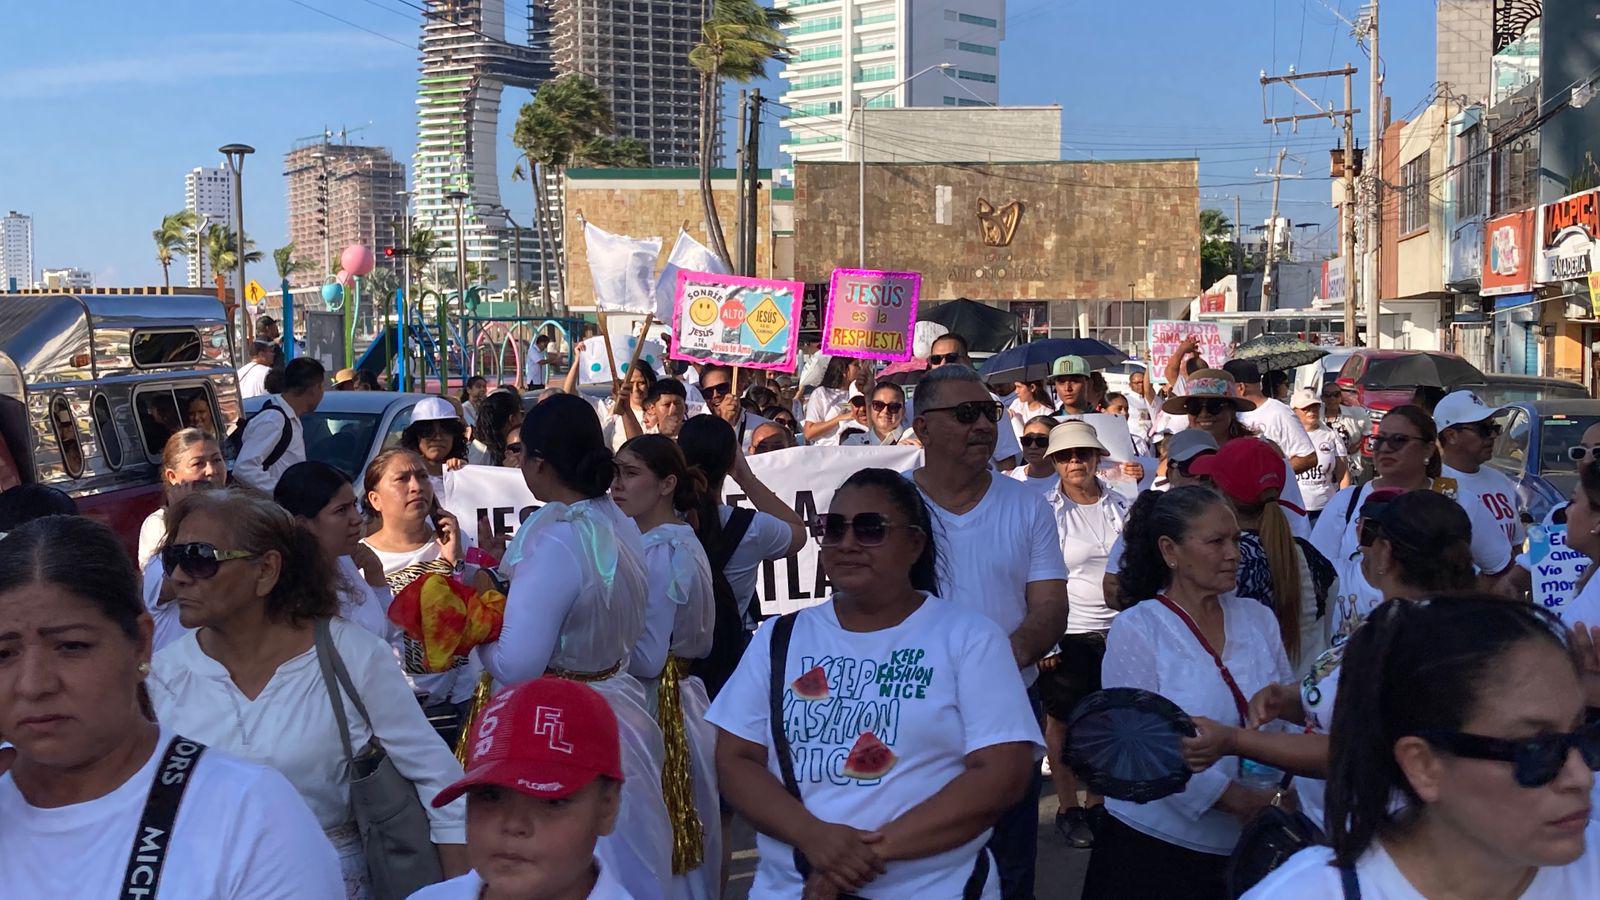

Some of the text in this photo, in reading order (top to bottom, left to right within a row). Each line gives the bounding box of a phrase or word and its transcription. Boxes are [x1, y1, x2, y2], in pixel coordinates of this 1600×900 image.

[688, 288, 723, 302] SONRÍE
[845, 281, 904, 308] JESÚS
[722, 309, 744, 320] ALTO
[756, 309, 777, 324] JESÚS
[852, 310, 887, 323] es la
[832, 328, 904, 349] RESPUESTA
[1544, 594, 1564, 607] de
[891, 648, 925, 666] KEEP
[875, 663, 934, 686] FASHION
[879, 684, 926, 699] NICE
[535, 706, 574, 753] FL
[162, 738, 200, 785] ORS
